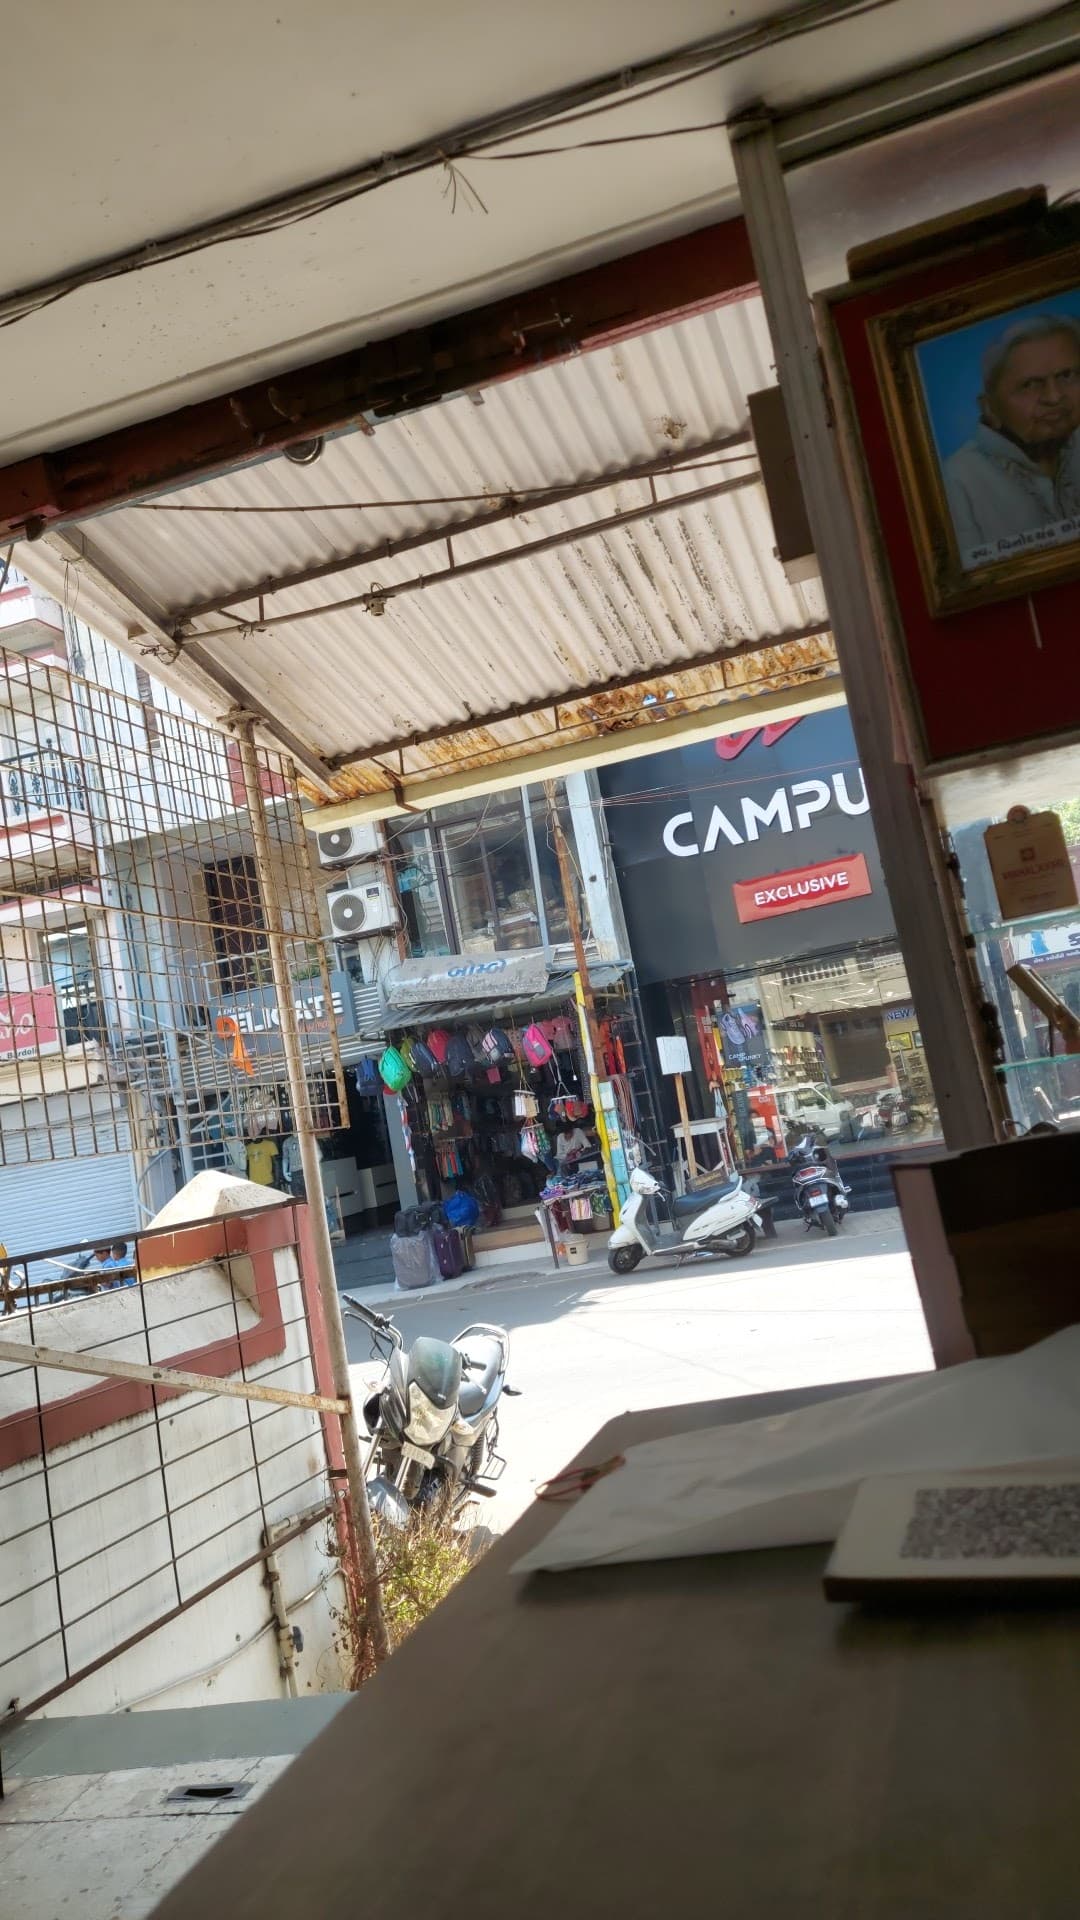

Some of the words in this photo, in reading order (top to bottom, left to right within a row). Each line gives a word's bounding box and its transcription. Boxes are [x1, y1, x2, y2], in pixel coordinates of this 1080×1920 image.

[754, 872, 849, 905] EXCLUSIVE
[216, 991, 344, 1036] ELIATE
[887, 1009, 910, 1021] NEW
[7, 1047, 39, 1059] Brdoli
